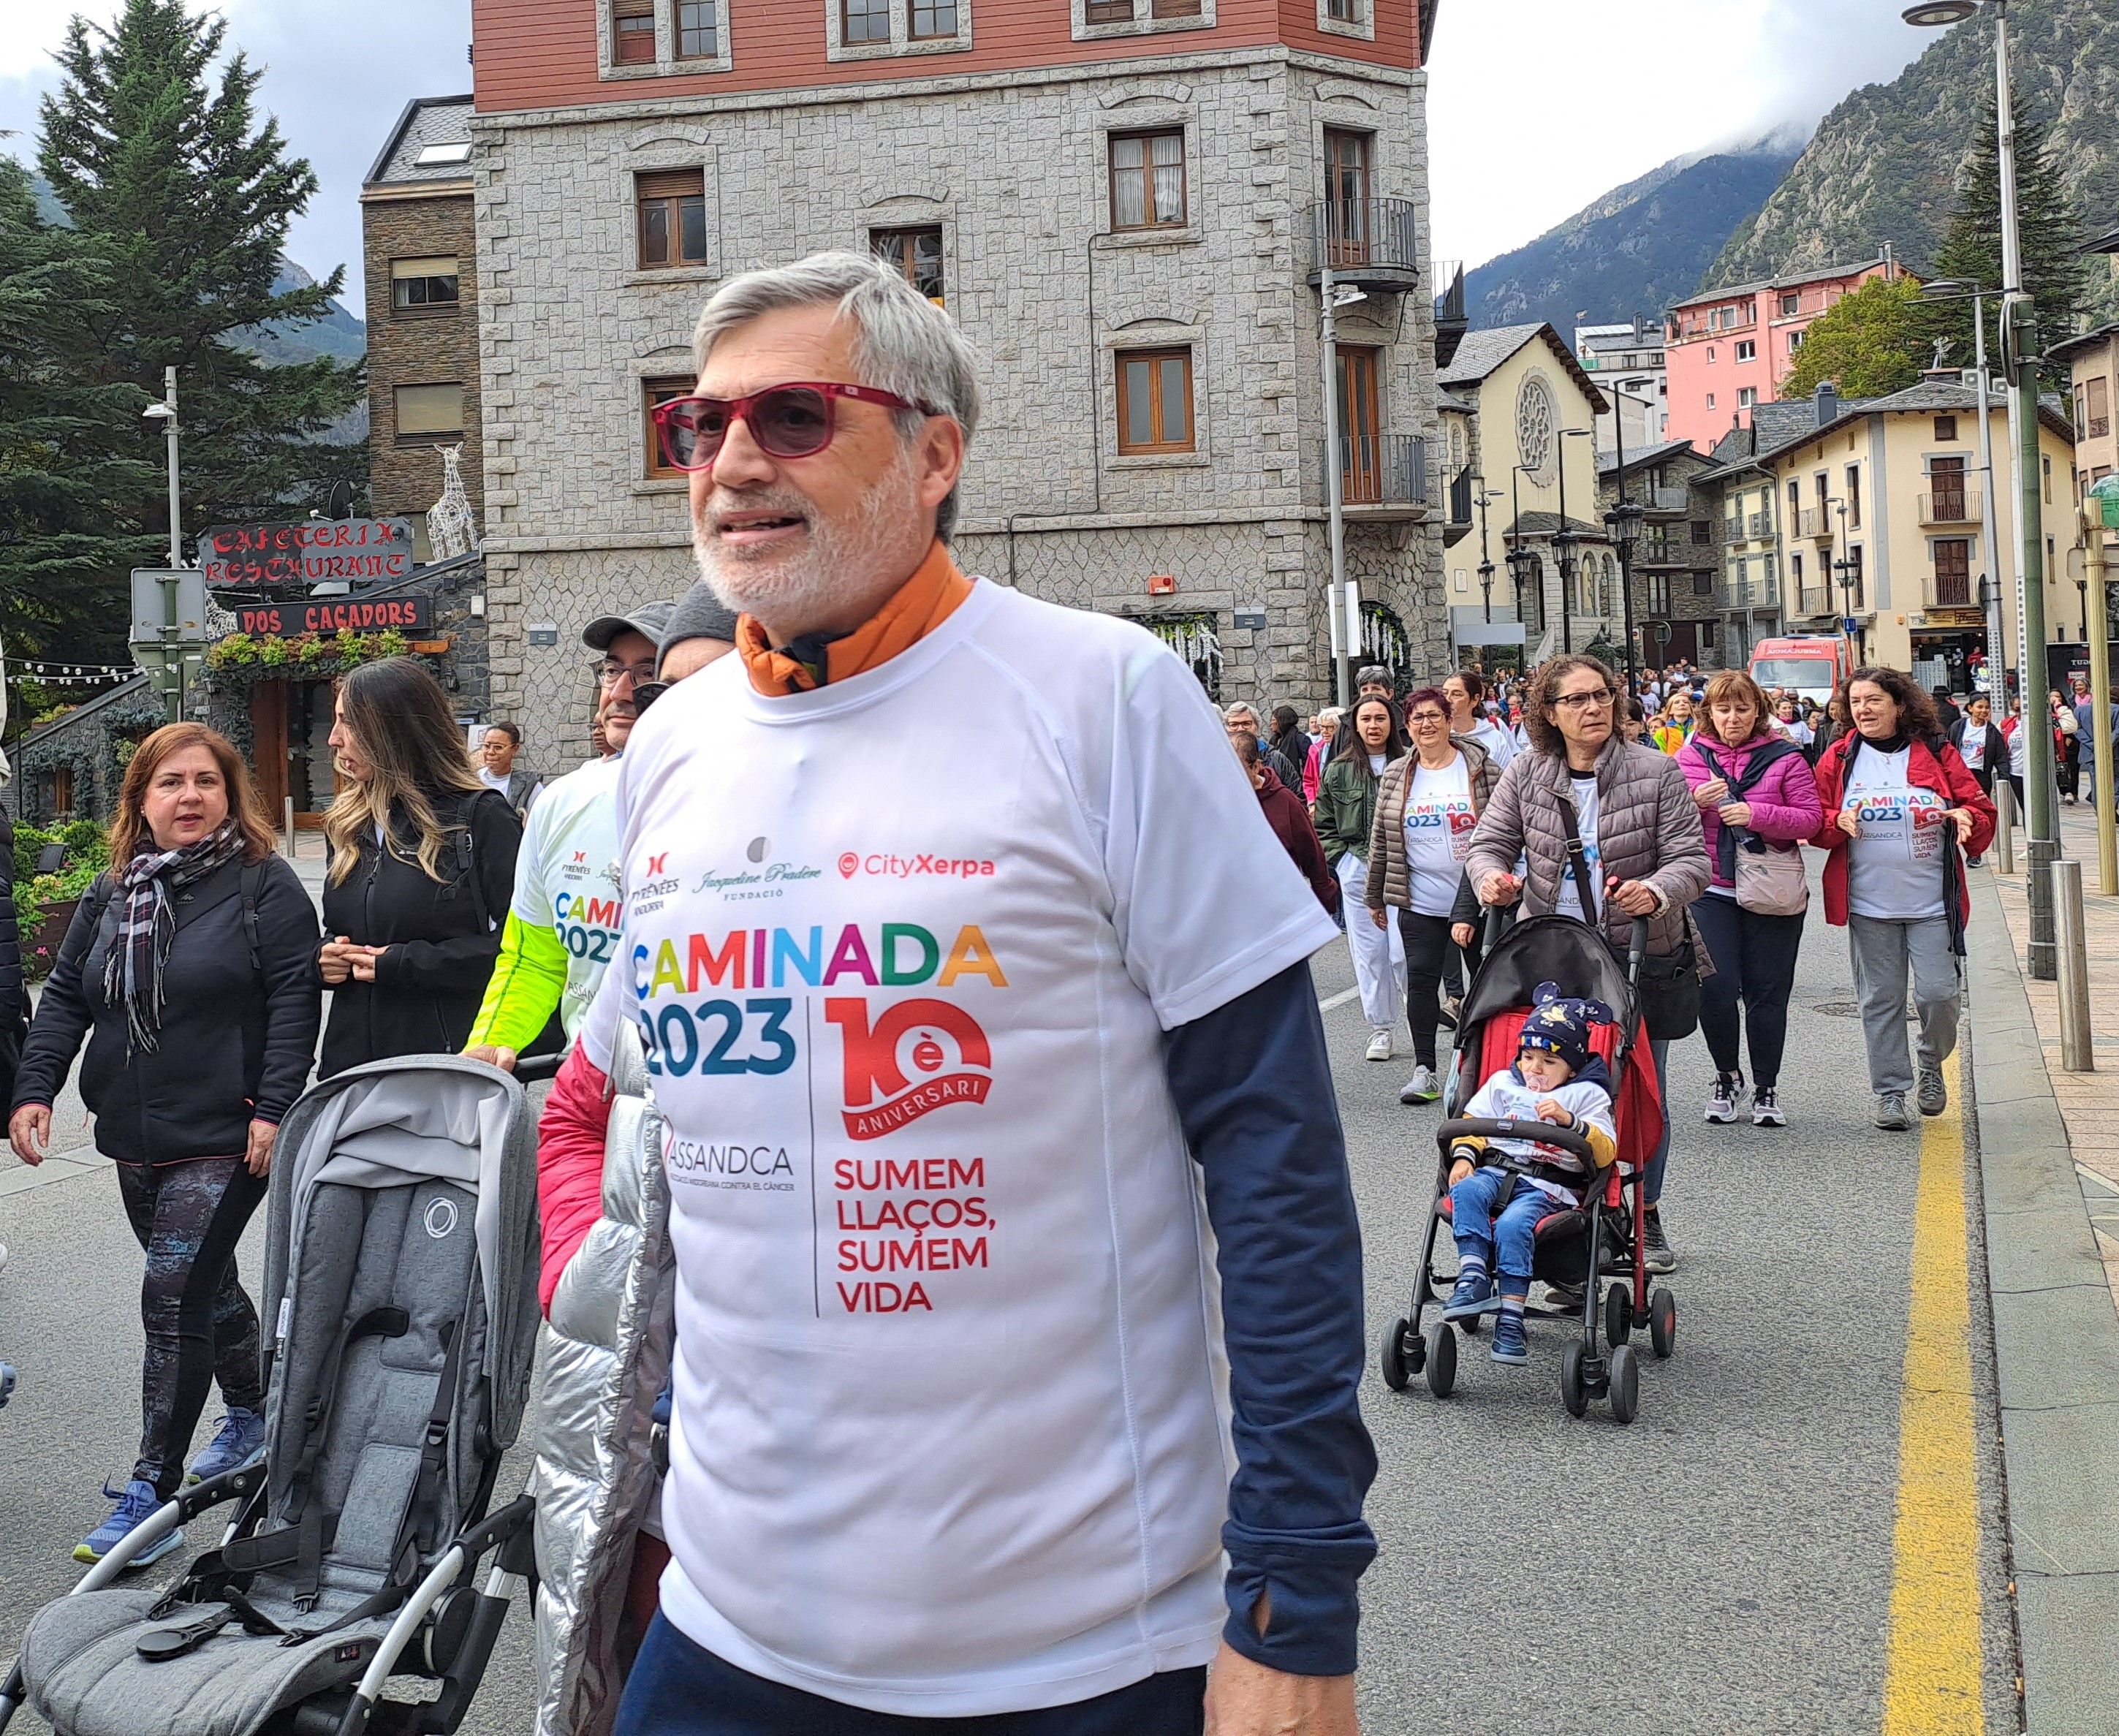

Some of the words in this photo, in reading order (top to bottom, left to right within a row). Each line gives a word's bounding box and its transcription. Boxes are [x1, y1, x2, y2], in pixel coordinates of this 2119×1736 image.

[213, 523, 395, 553] CAFETERIA
[205, 553, 406, 582] RESTAURANT
[243, 610, 282, 634] DOS
[1847, 795, 1943, 808] CAMINADA
[865, 853, 995, 879] CityXerpa
[556, 892, 625, 930] CAMI
[633, 922, 1009, 1001] CAMINADA
[857, 1080, 979, 1134] ANIVERSARI
[669, 1140, 794, 1175] ASSANDCA
[834, 1158, 984, 1191] SUMEM
[836, 1197, 996, 1237] LLAÇOS,
[837, 1237, 988, 1272] SUMEM
[836, 1281, 933, 1313] VIDA
